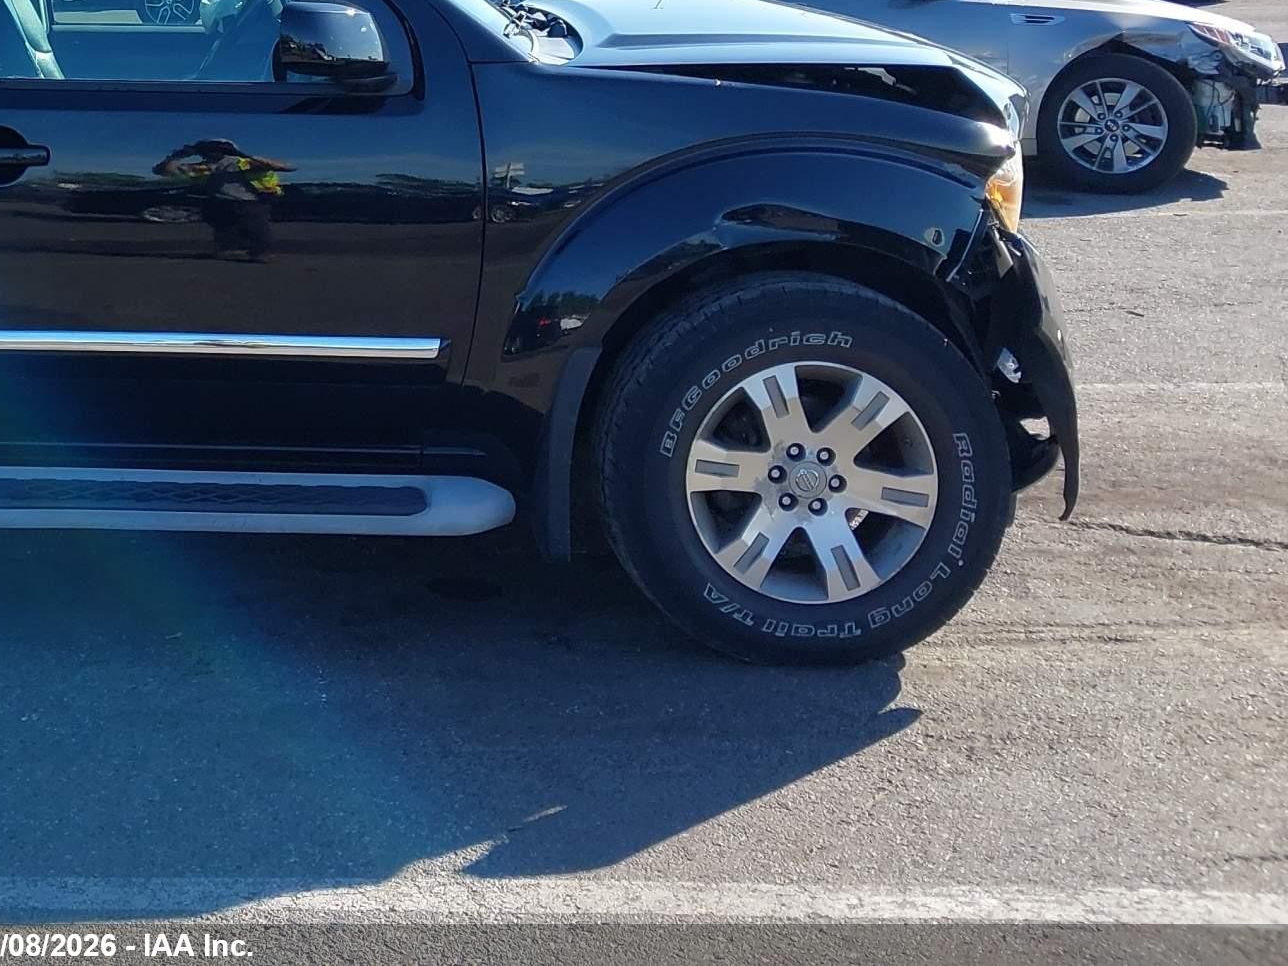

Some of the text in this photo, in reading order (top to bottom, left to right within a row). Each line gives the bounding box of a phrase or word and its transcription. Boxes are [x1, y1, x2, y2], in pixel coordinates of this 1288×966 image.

[659, 330, 853, 459] BFGoodrich
[703, 432, 978, 639] Radial Long Trail T/A
